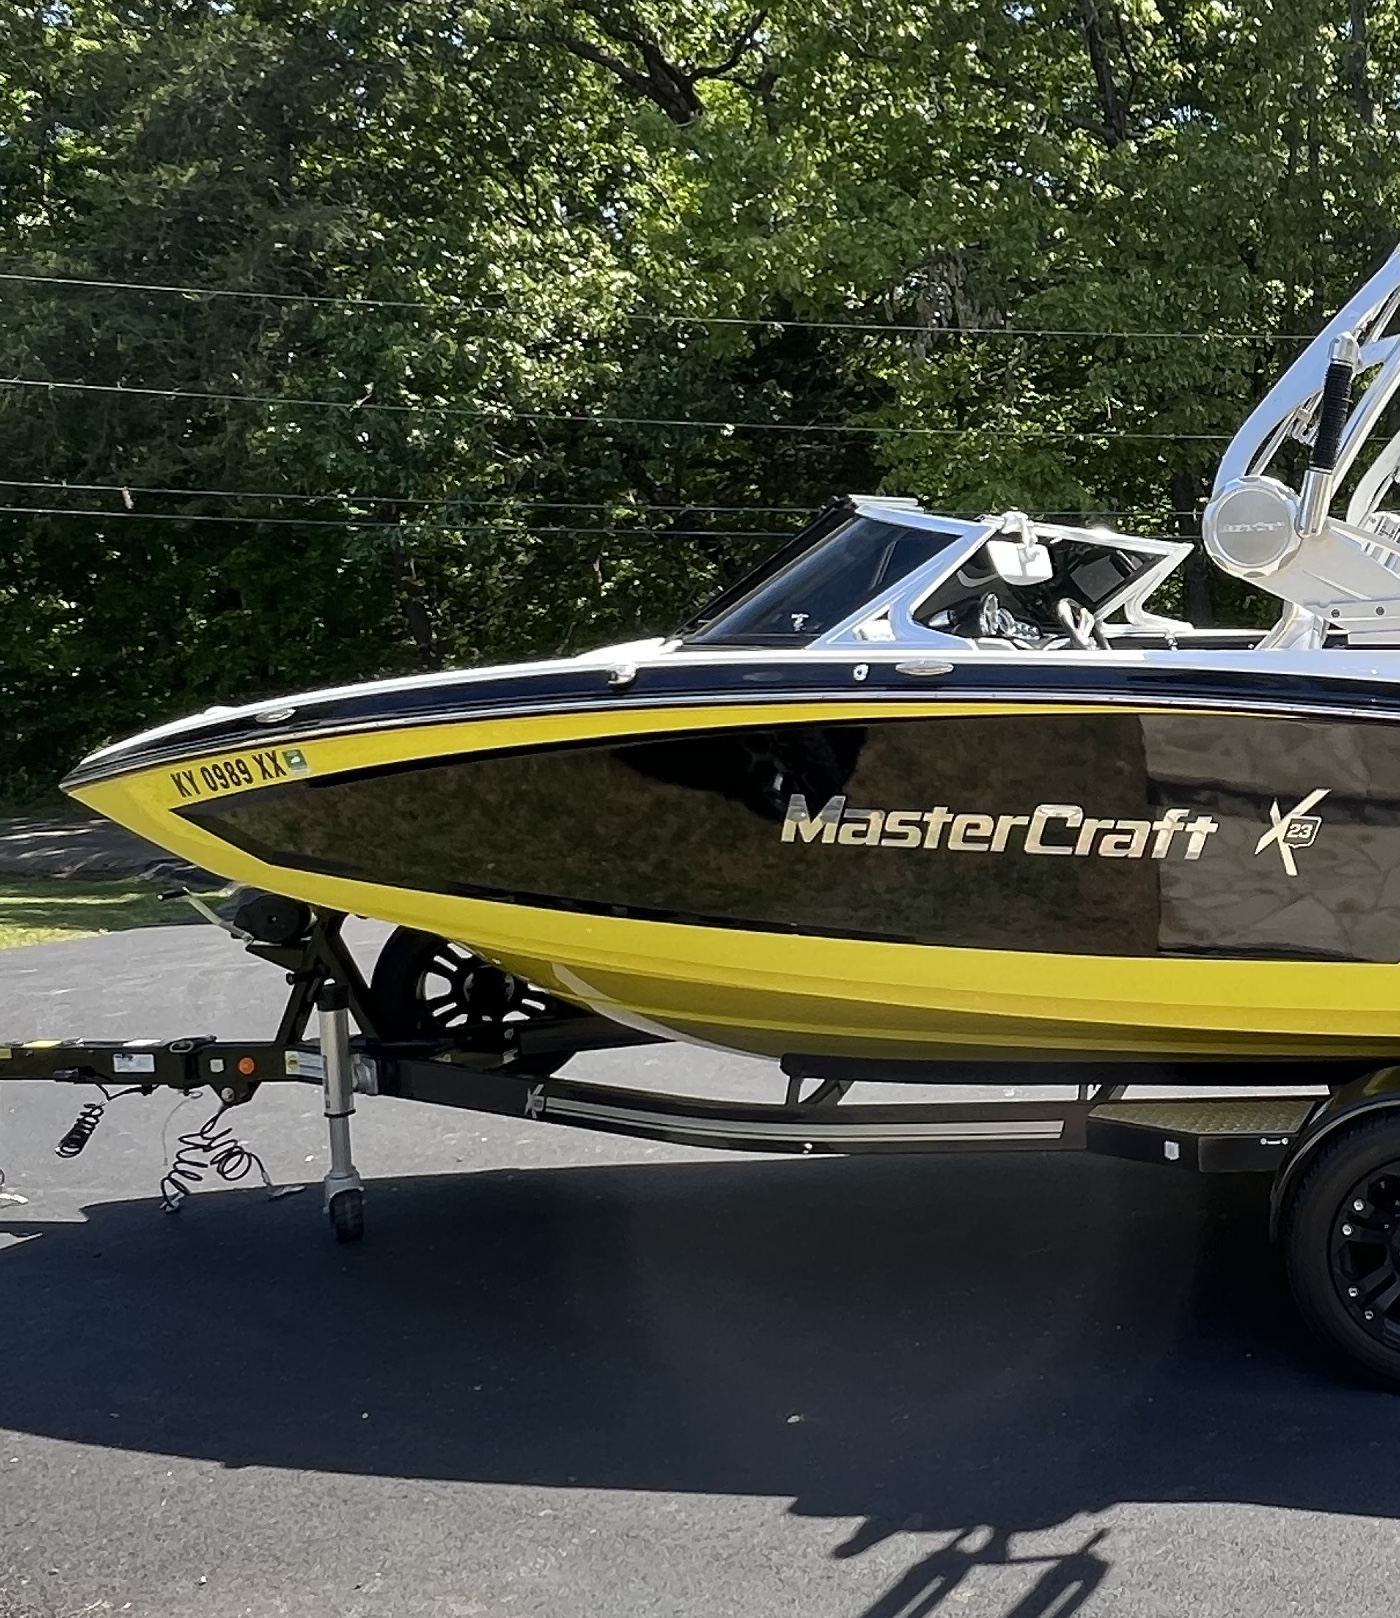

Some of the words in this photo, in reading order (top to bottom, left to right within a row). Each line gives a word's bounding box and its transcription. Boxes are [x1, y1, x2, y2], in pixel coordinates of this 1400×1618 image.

[170, 769, 201, 798] KY
[199, 758, 254, 792] 0989
[251, 750, 287, 781] XX
[779, 793, 1219, 861] MasterCraft
